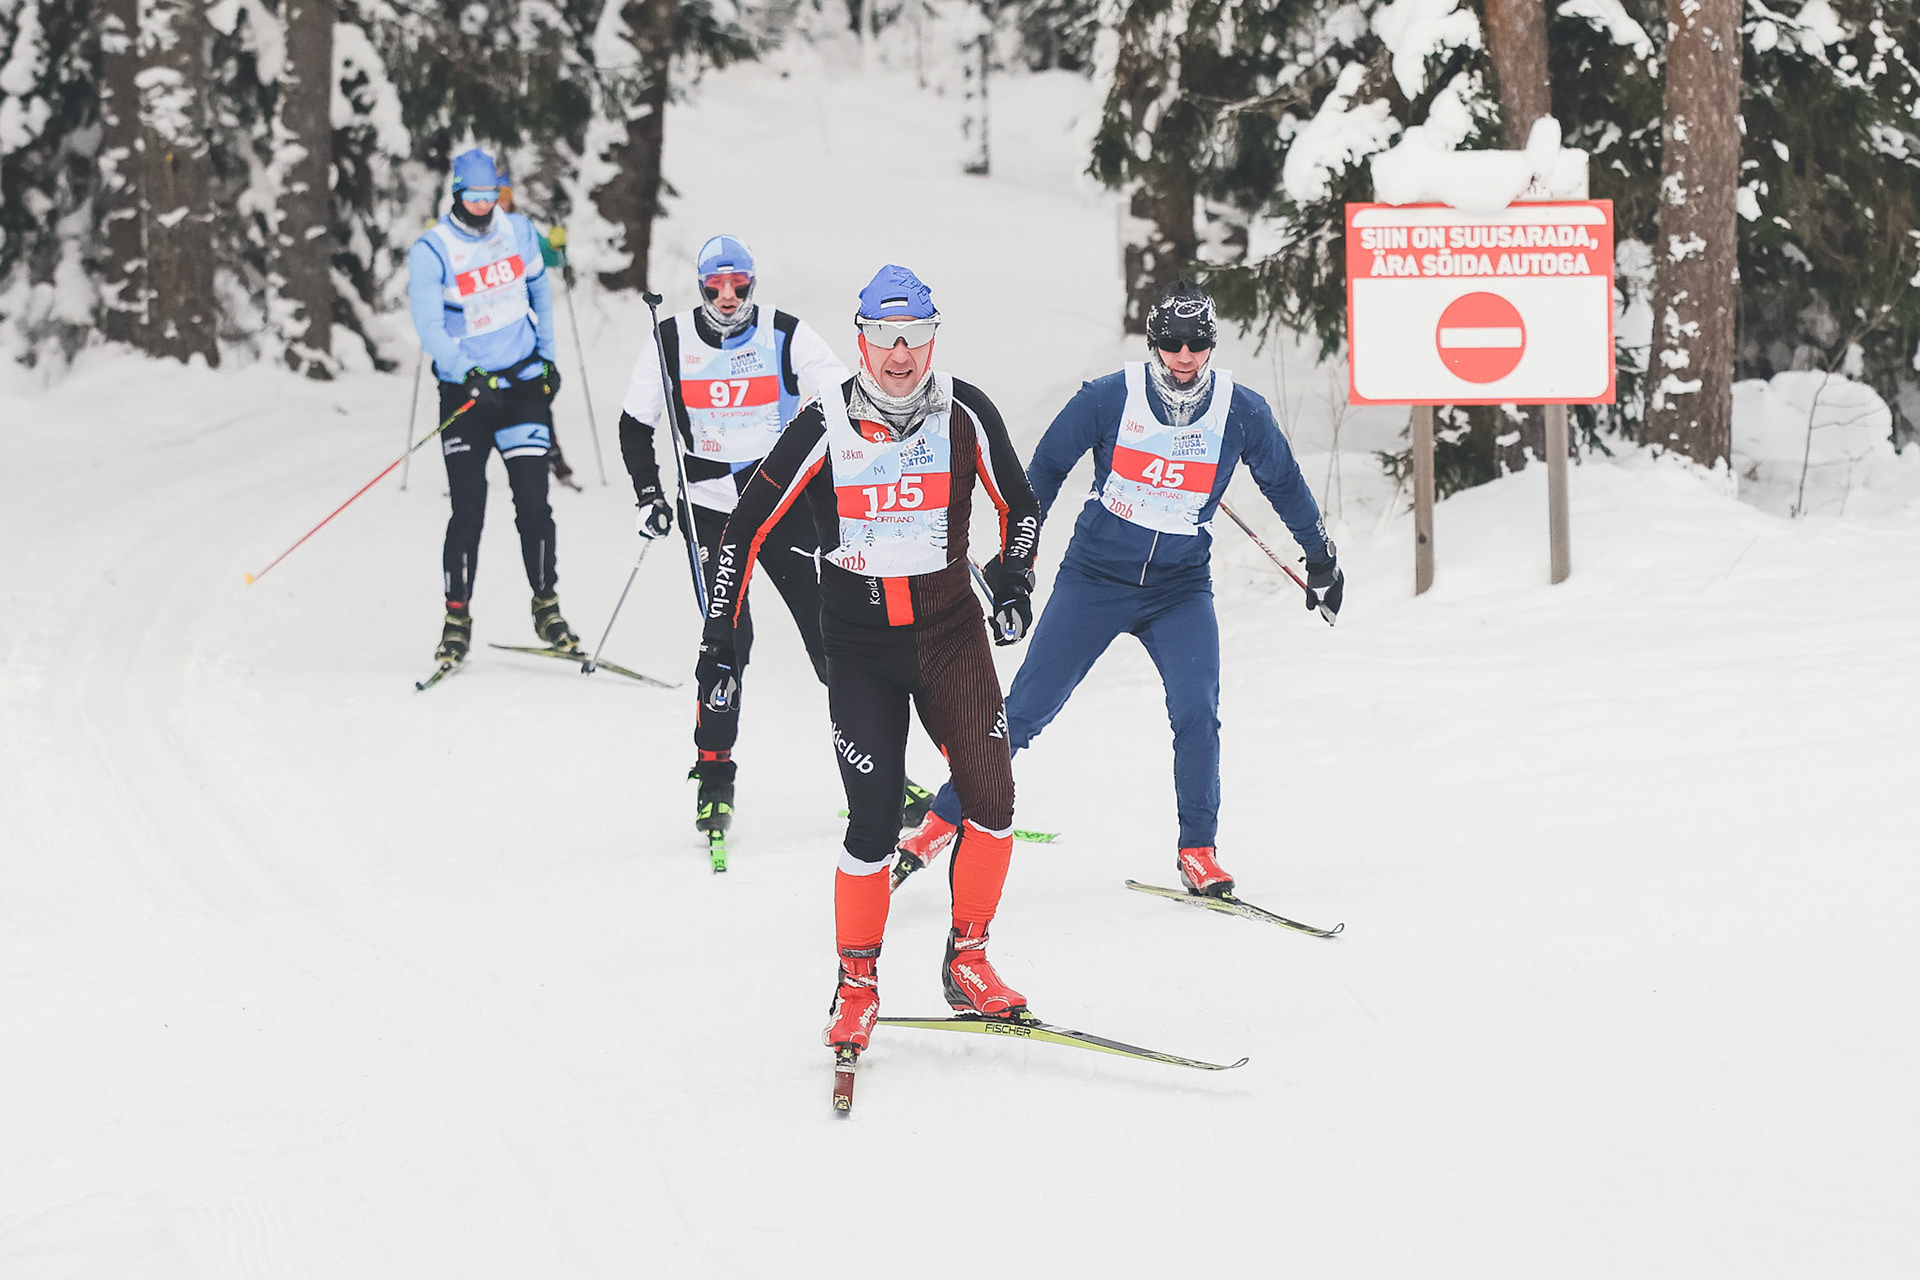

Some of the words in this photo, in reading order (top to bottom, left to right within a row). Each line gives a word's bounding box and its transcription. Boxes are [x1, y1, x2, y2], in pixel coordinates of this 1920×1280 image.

[1360, 226, 1408, 249] SIIN
[1411, 226, 1446, 249] ON
[1449, 225, 1599, 250] SUUSARADA,
[1370, 249, 1420, 277] ÄRA
[1422, 248, 1494, 276] SÕIDA
[1496, 252, 1590, 275] AUTOGA
[468, 260, 516, 293] 148
[709, 380, 750, 408] 97
[1125, 420, 1145, 434] 38km
[841, 450, 864, 461] 38km
[873, 465, 886, 475] M
[1142, 458, 1186, 488] 45
[874, 515, 915, 523] ORTLAND
[1109, 498, 1133, 519] 2026
[1183, 853, 1208, 877] alpina
[957, 963, 988, 993] alpina
[985, 1023, 1032, 1038] FISCHER
